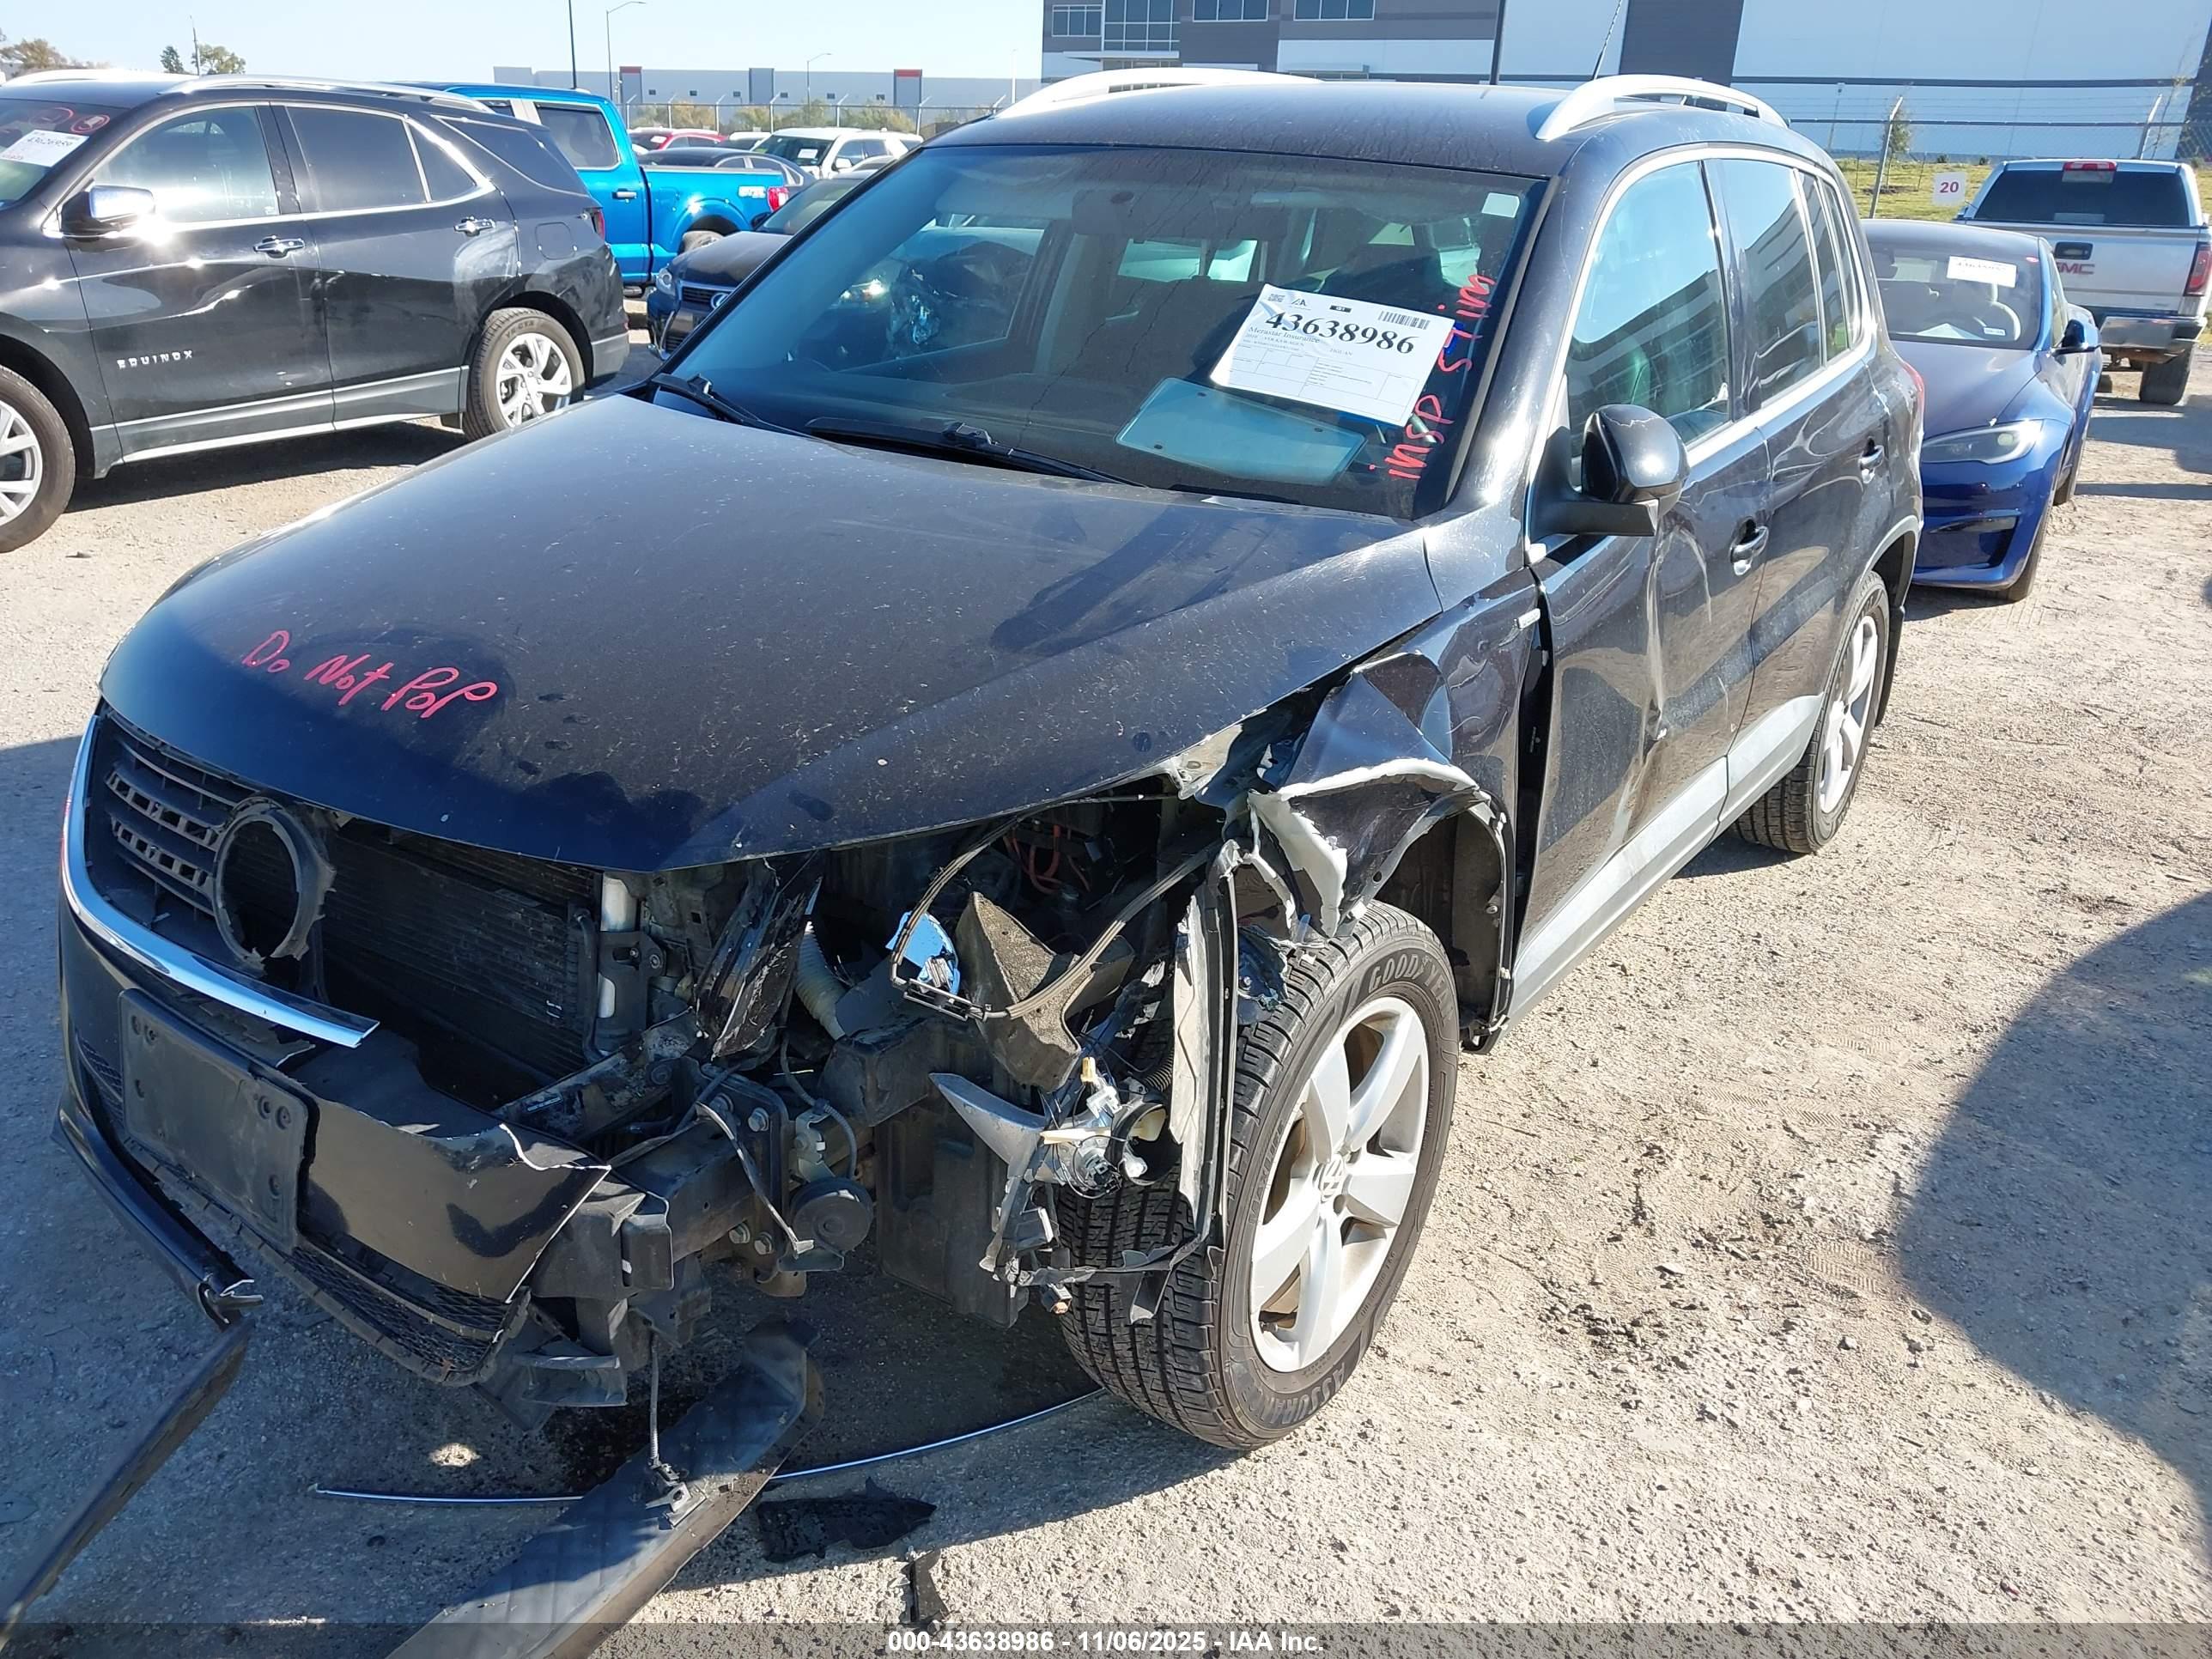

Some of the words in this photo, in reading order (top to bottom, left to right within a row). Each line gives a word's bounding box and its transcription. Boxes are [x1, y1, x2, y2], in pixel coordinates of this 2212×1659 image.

[1940, 181, 1960, 193] 20
[2056, 261, 2095, 275] MC
[1265, 311, 1419, 354] 43638986
[1283, 332, 1321, 343] Insurance
[117, 349, 193, 369] EQUINOX
[241, 629, 291, 673] Do
[303, 653, 395, 707] Not
